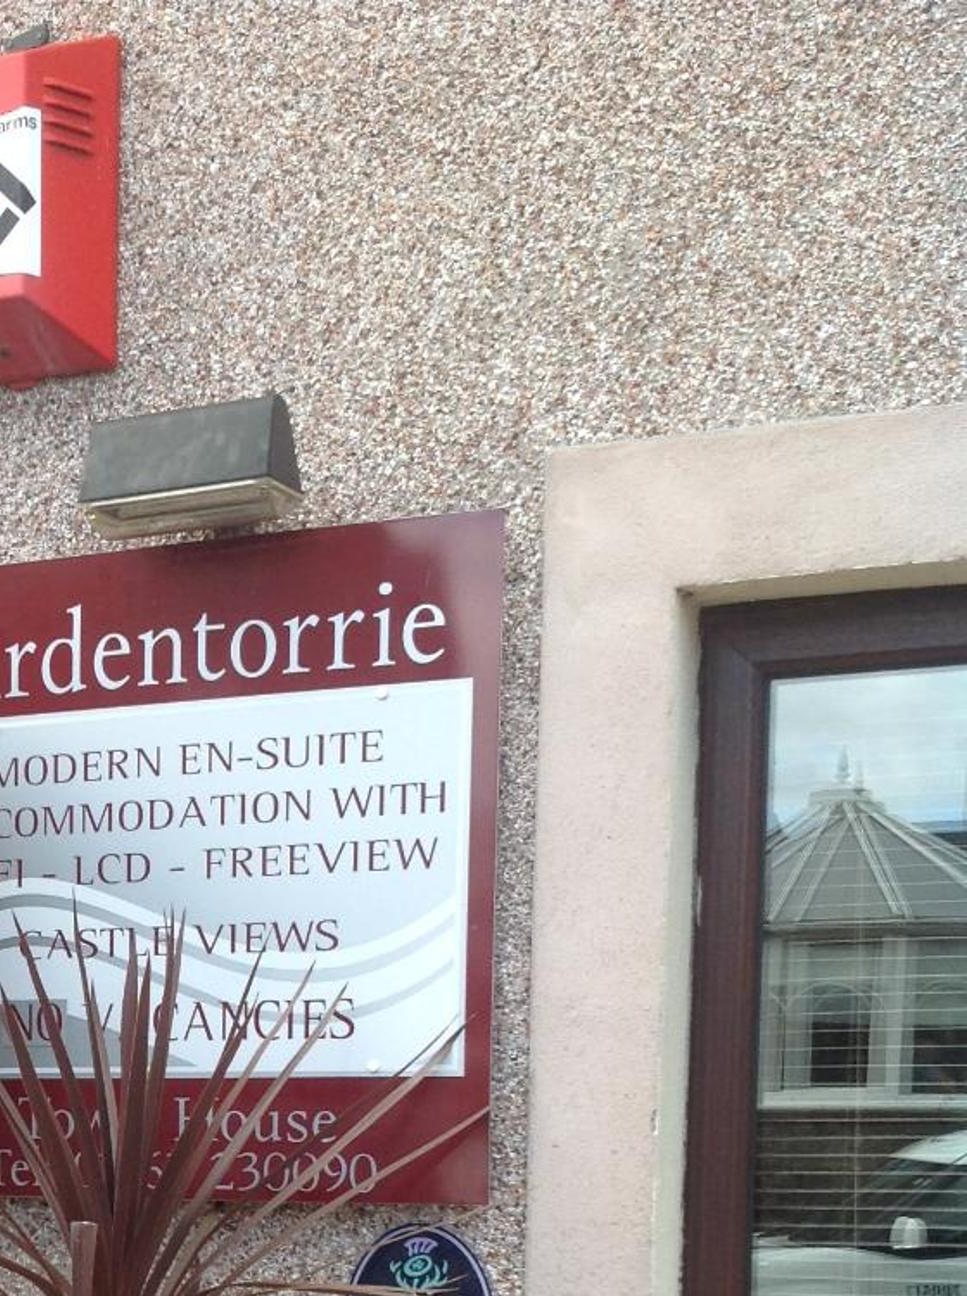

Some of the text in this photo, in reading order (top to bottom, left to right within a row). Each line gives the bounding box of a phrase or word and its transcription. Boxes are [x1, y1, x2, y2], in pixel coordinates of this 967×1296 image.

[180, 729, 385, 777] EN-SUITE
[333, 780, 447, 821] WITH
[73, 852, 151, 886] LCD
[205, 837, 439, 880] FREEVIEW
[19, 919, 339, 960] CASTLE VIEWS
[7, 998, 355, 1042] NO CANCIES
